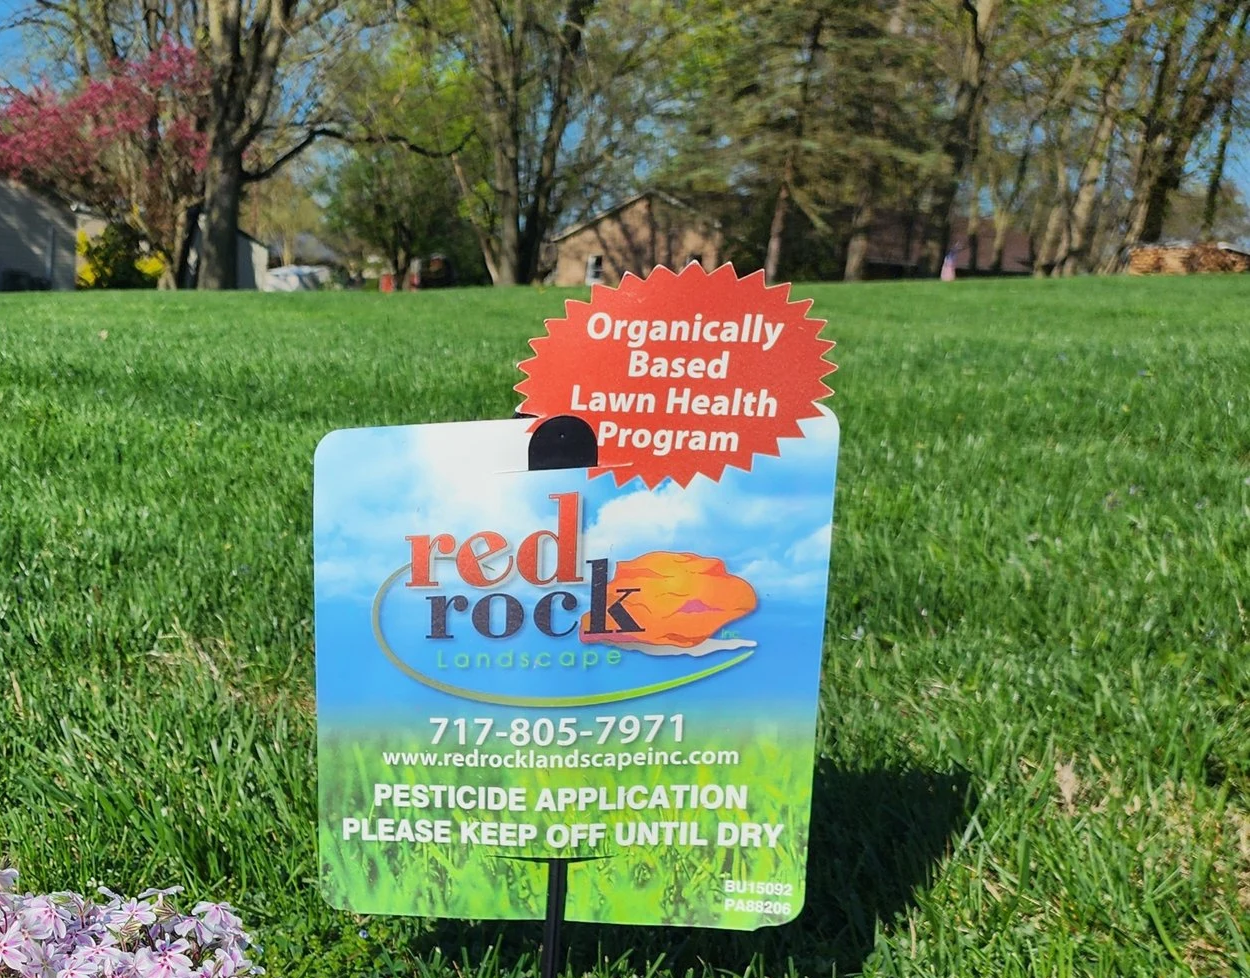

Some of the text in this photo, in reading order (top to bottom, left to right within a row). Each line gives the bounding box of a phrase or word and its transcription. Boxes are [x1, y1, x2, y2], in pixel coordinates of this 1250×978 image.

[586, 312, 785, 351] Organically
[628, 351, 730, 379] Based
[570, 384, 778, 418] Lawn Health
[598, 421, 739, 456] Program
[405, 492, 584, 588] red
[425, 558, 646, 640] rock
[437, 650, 622, 669] Landscape
[429, 714, 684, 747] 717-805-7971
[382, 747, 740, 771] www.redrocklandscapeinc.com
[374, 784, 748, 812] PESTICIDE APPLICATION
[342, 818, 784, 848] PLEASE KEEP OFF UNTIL DRY
[724, 880, 793, 896] BU15092
[724, 898, 792, 915] PA88206
